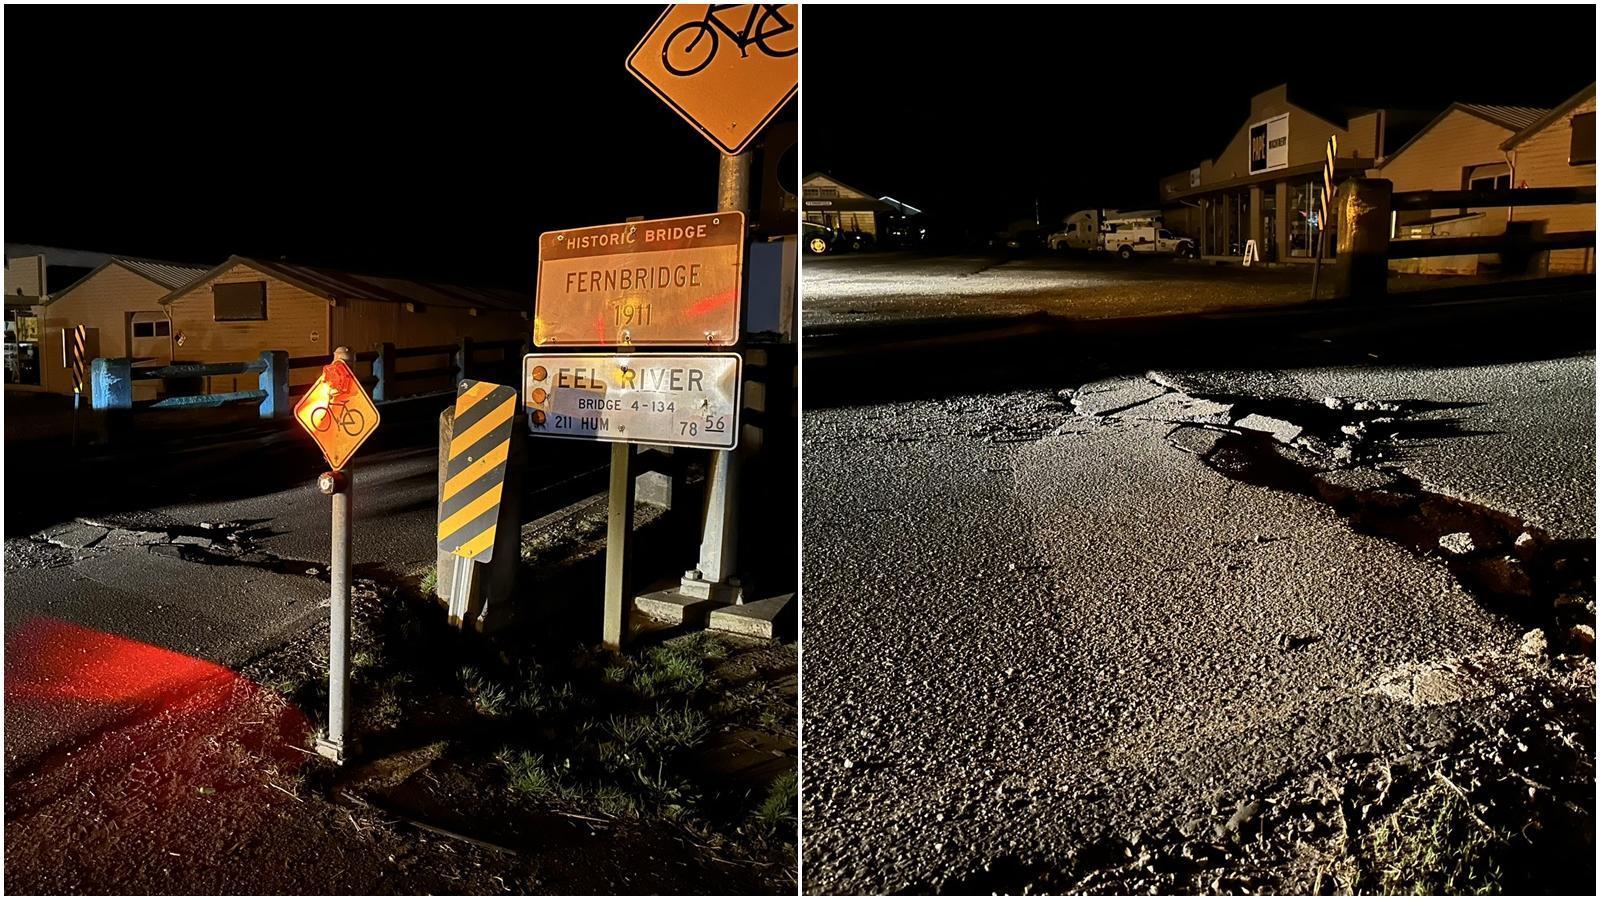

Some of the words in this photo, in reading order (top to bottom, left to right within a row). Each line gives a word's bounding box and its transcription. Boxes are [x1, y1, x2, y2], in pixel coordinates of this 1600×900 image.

[567, 231, 636, 250] HISTORIC
[645, 224, 707, 243] BRIDGE
[566, 264, 701, 293] FERNBRIDGE
[614, 303, 652, 326] 1911
[558, 368, 604, 389] EEL
[621, 368, 704, 392] RIVER
[578, 398, 622, 411] BRIDGE
[631, 400, 675, 413] 4-134
[555, 415, 572, 429] 211
[581, 416, 609, 431] HUM
[680, 421, 698, 437] 78
[705, 415, 725, 430] 56
